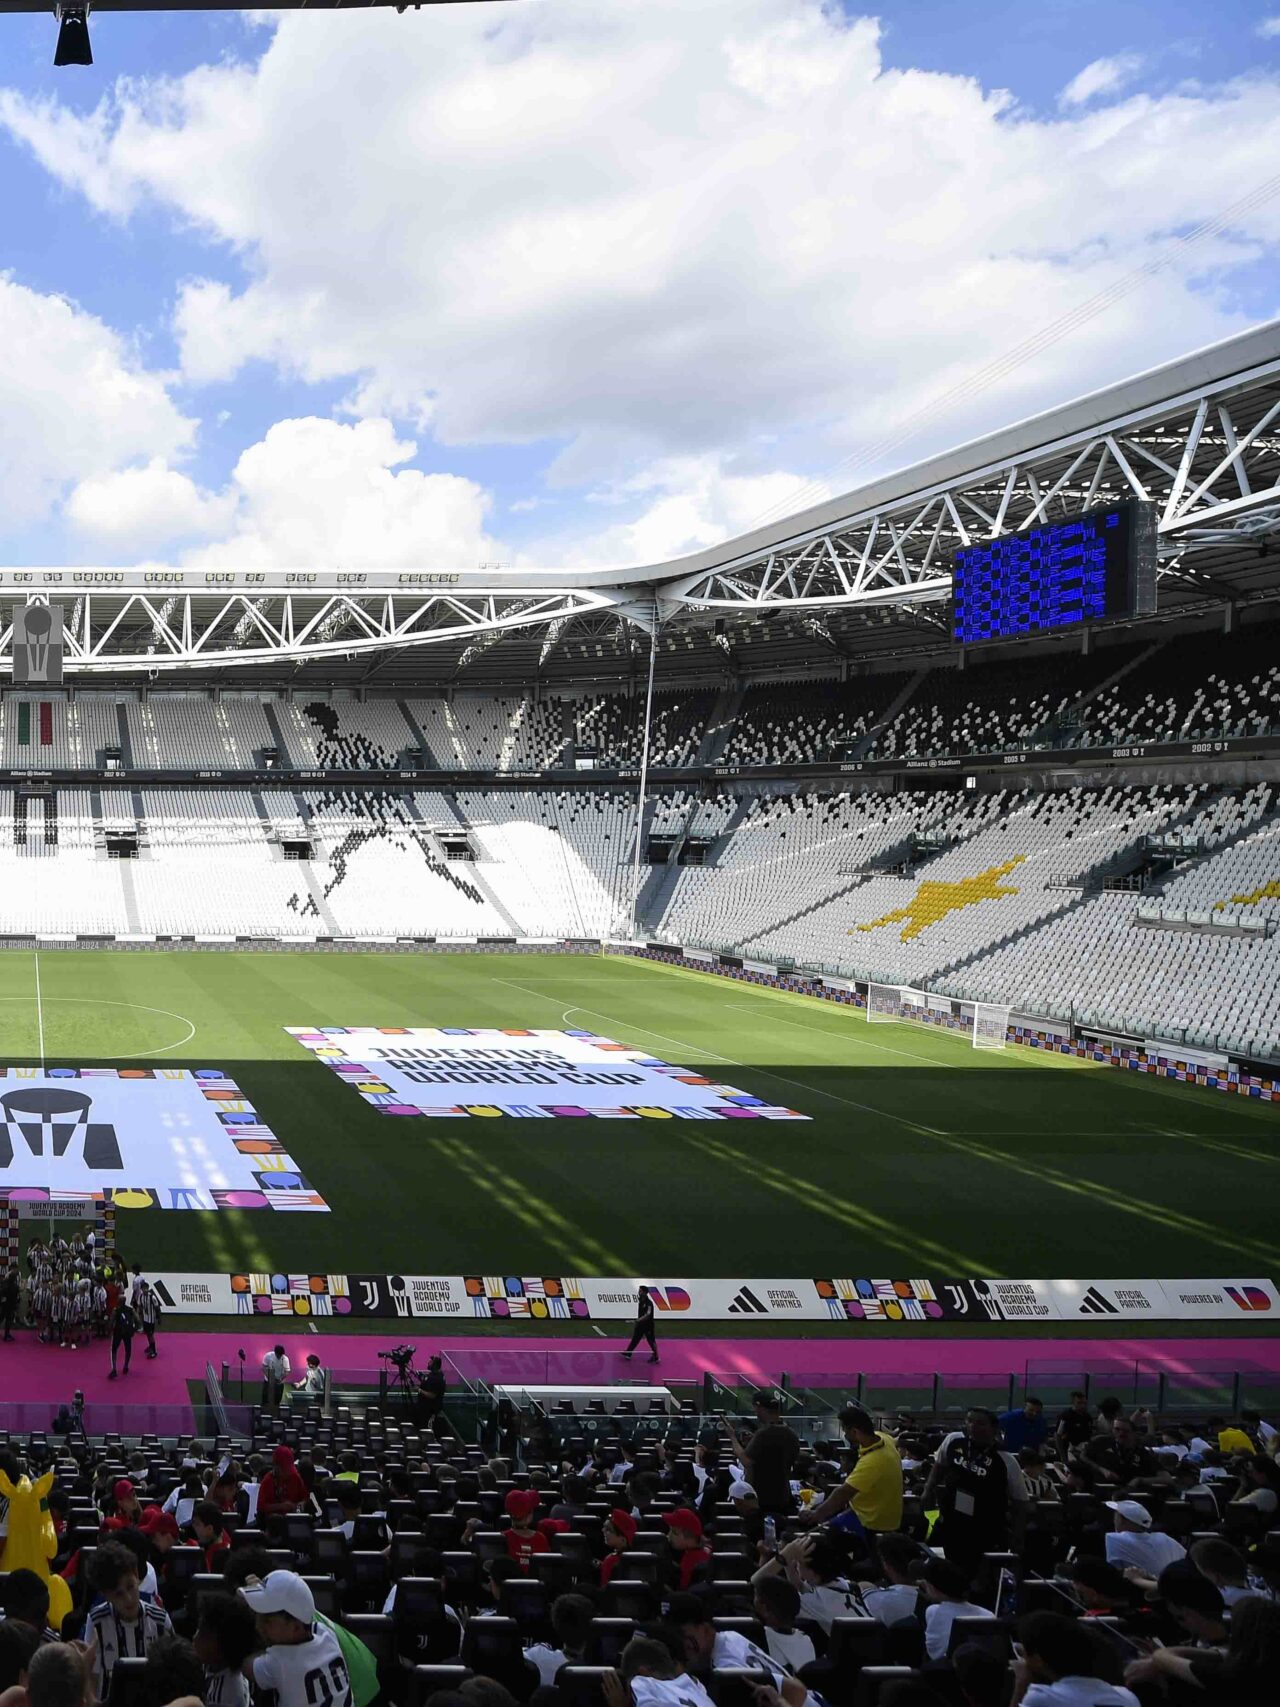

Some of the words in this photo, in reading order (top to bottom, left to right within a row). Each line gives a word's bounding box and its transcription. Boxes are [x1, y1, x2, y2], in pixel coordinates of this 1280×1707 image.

[1112, 749, 1129, 757] 2003
[1192, 744, 1211, 753] 2002
[906, 760, 928, 768] Allianz
[9, 941, 40, 949] ACADEMY
[42, 941, 65, 950] WORLD
[67, 942, 80, 950] CUP
[81, 942, 99, 950] 2024
[368, 1048, 566, 1060] JUVENTUS
[385, 1060, 578, 1071] ACADEMY
[401, 1071, 558, 1084] WORLD
[557, 1073, 647, 1085] CUP
[32, 1209, 53, 1217] WORLD
[181, 1284, 210, 1294] OFFICIAL
[412, 1281, 450, 1291] JUVENTUS
[995, 1284, 1034, 1295] JUVENTUS
[182, 1293, 212, 1303] PARTNER
[414, 1291, 450, 1301] ACADEMY
[598, 1294, 631, 1303] POWERED
[767, 1290, 798, 1299] OFFICIAL
[1114, 1290, 1146, 1299] OFFICIAL
[1179, 1295, 1214, 1304] POWERED
[1213, 1295, 1223, 1304] BY
[770, 1299, 802, 1309] PARTNER
[1000, 1295, 1037, 1305] ACADEMY
[1119, 1299, 1152, 1309] PARTNER
[416, 1302, 443, 1312] WORLD
[444, 1302, 460, 1312] CUP
[1004, 1305, 1033, 1315] WORLD
[1033, 1305, 1049, 1315] CUP
[954, 1456, 987, 1476] Jeep
